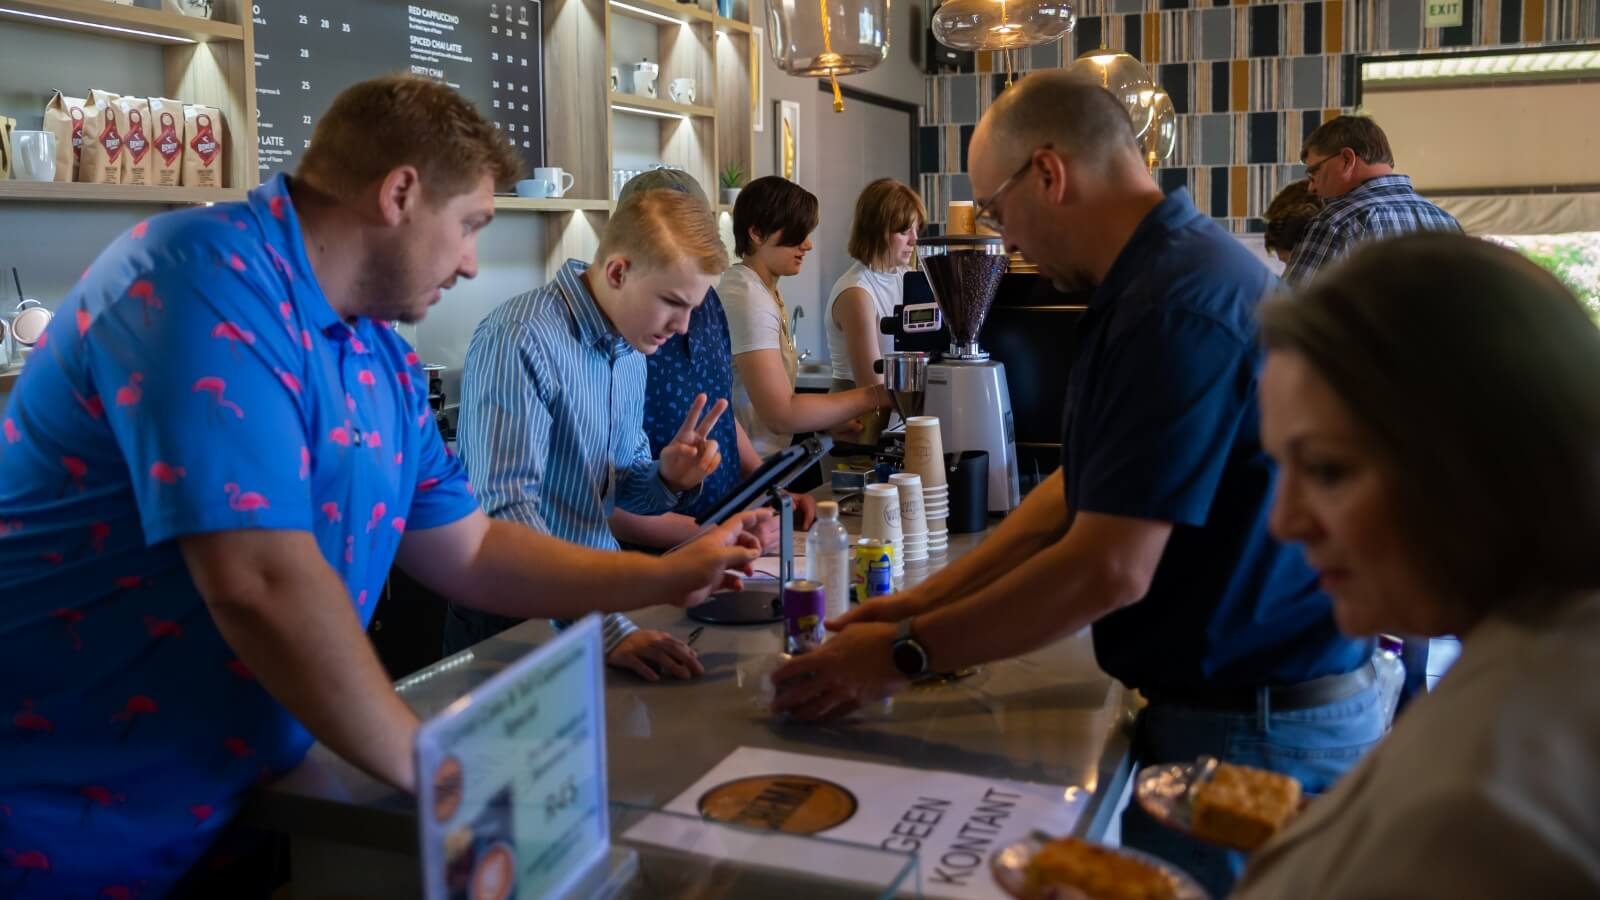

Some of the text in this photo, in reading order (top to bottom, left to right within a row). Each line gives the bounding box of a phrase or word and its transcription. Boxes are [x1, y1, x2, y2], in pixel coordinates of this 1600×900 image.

[1430, 3, 1458, 16] EXIT
[299, 14, 308, 25] 25
[421, 8, 460, 25] CAPPUCCINO
[410, 35, 431, 47] SPICED
[447, 43, 463, 54] LATTE
[301, 80, 311, 90] 25
[303, 115, 312, 124] 22
[261, 135, 285, 147] LATTE
[880, 796, 952, 855] GEEN
[929, 787, 1022, 886] KONTANT
